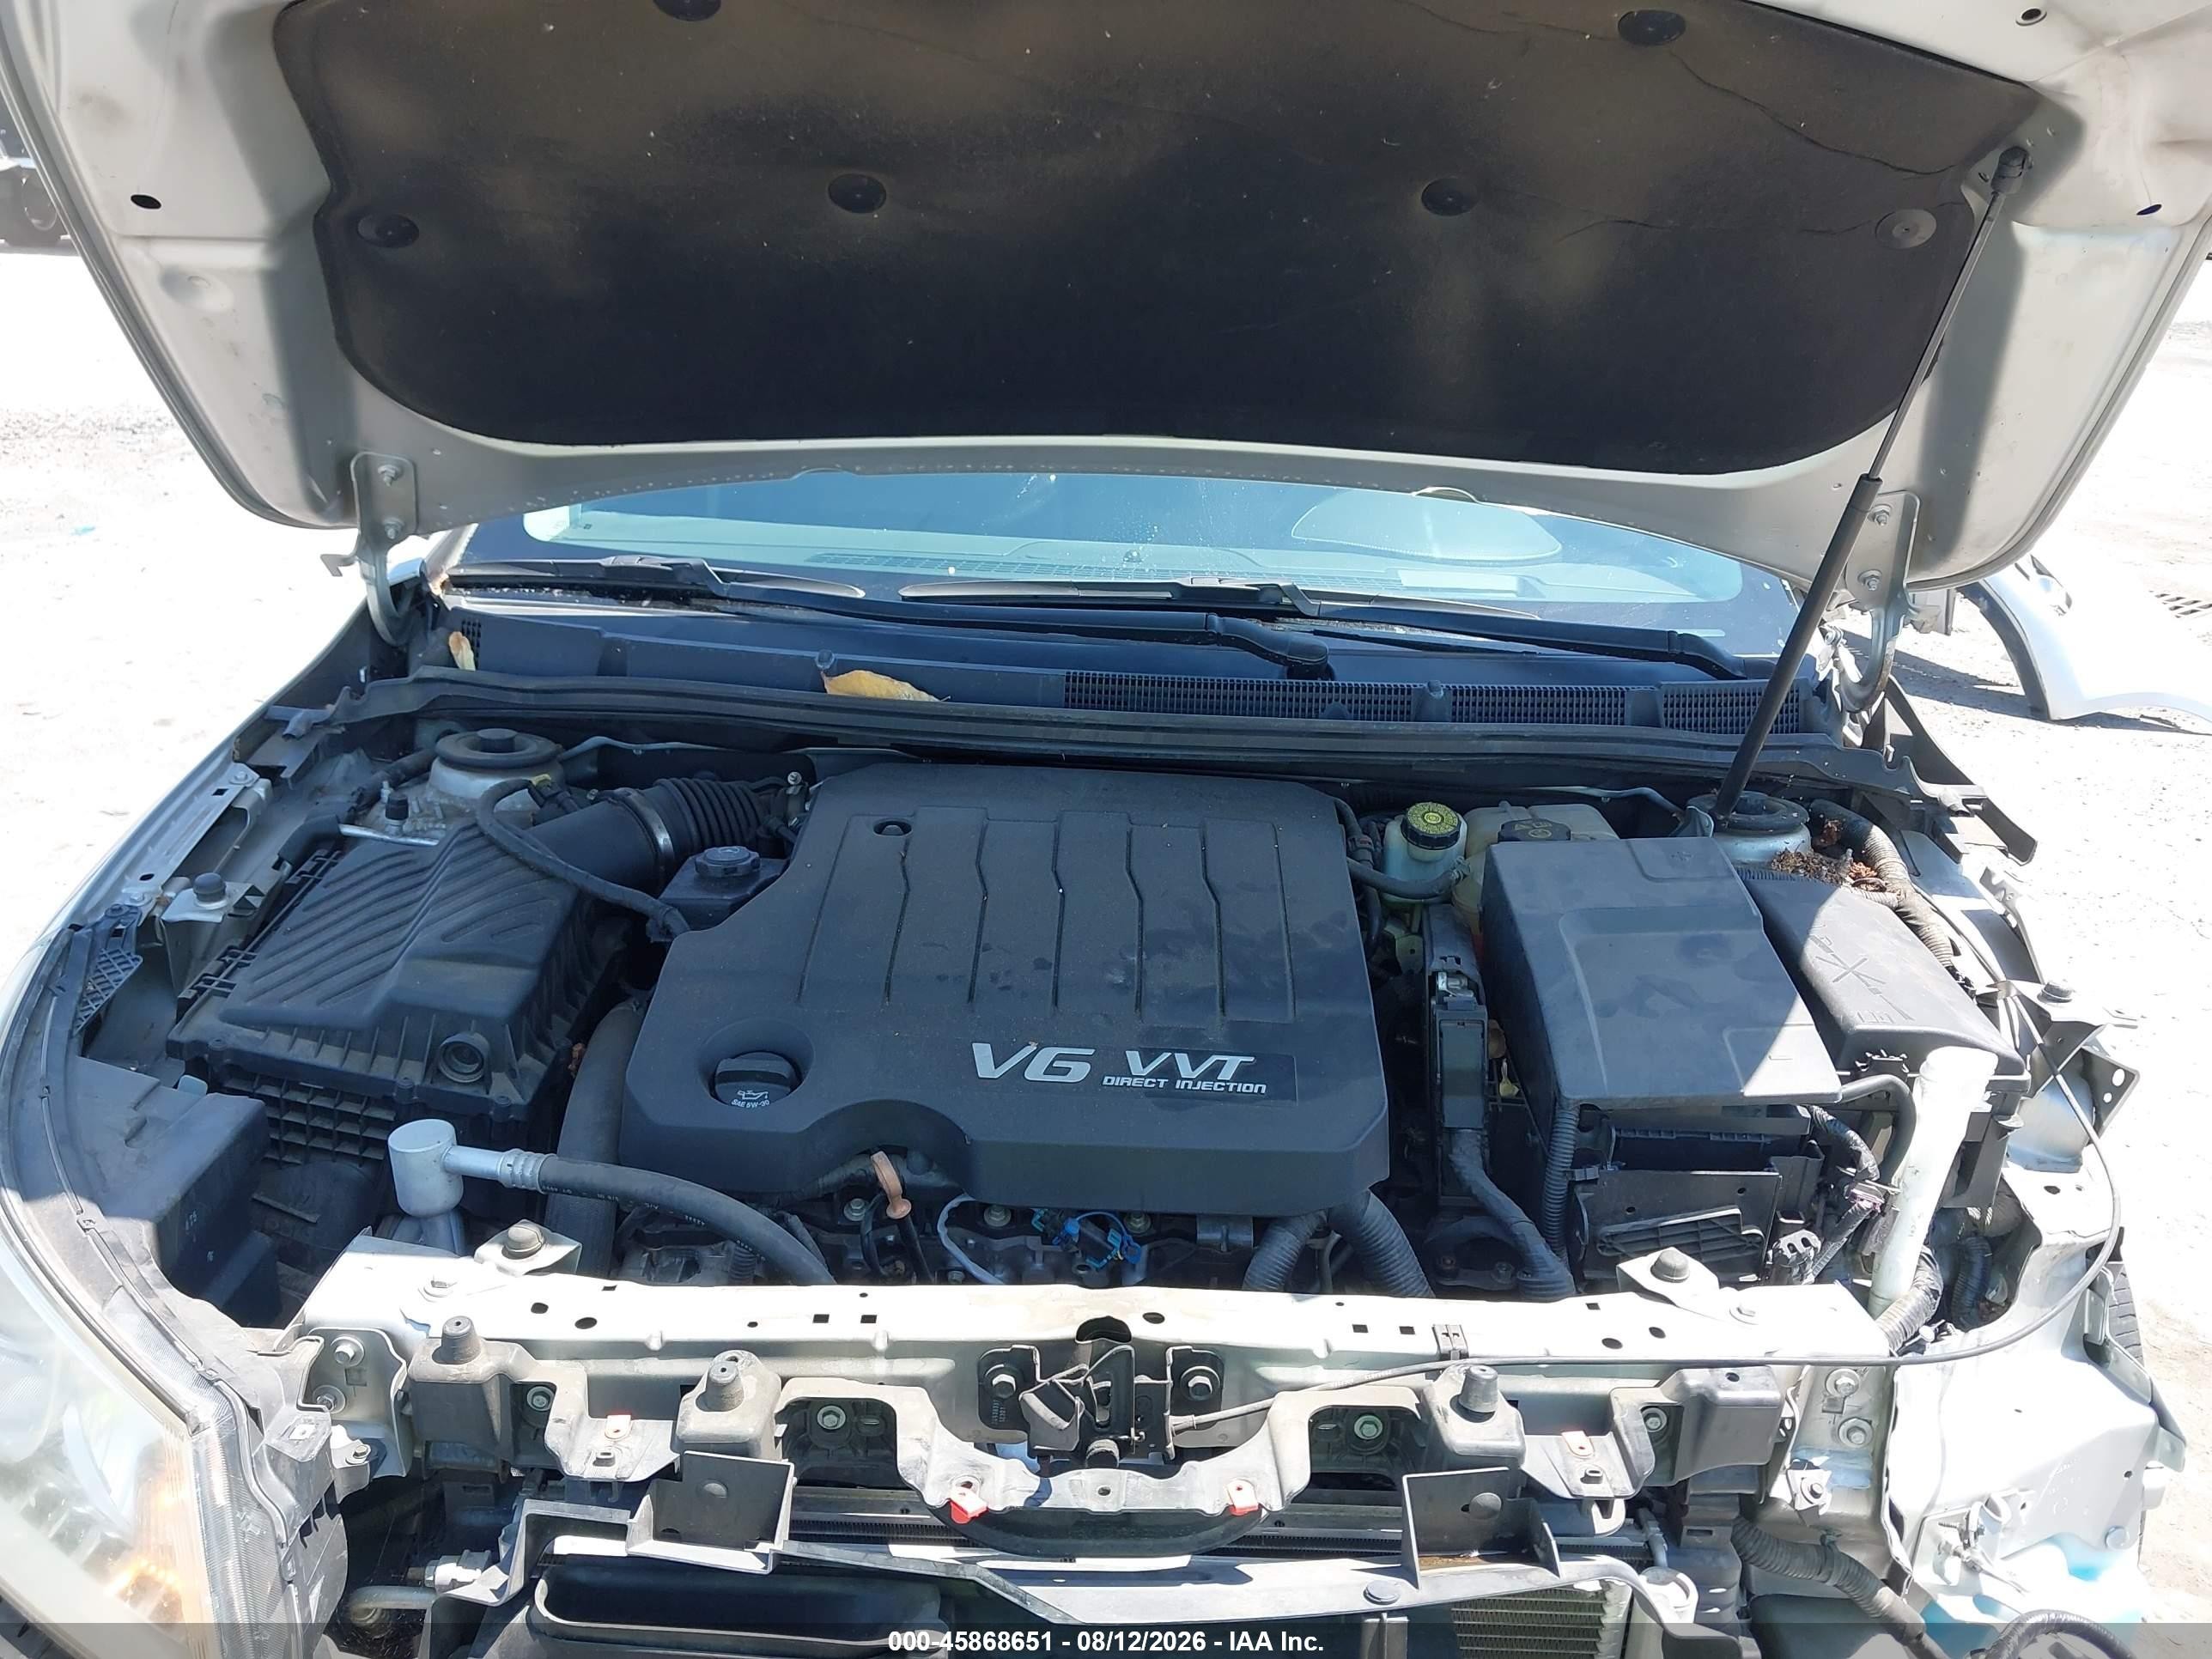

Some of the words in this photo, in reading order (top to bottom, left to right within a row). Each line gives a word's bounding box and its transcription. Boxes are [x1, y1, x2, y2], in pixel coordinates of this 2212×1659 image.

[971, 1042, 1096, 1083] V6
[1125, 1050, 1255, 1080] VVT
[1102, 1076, 1169, 1089] DIRECT
[1175, 1079, 1267, 1094] INJECTION
[731, 1099, 746, 1108] SAE
[745, 1099, 770, 1109] 5W-30
